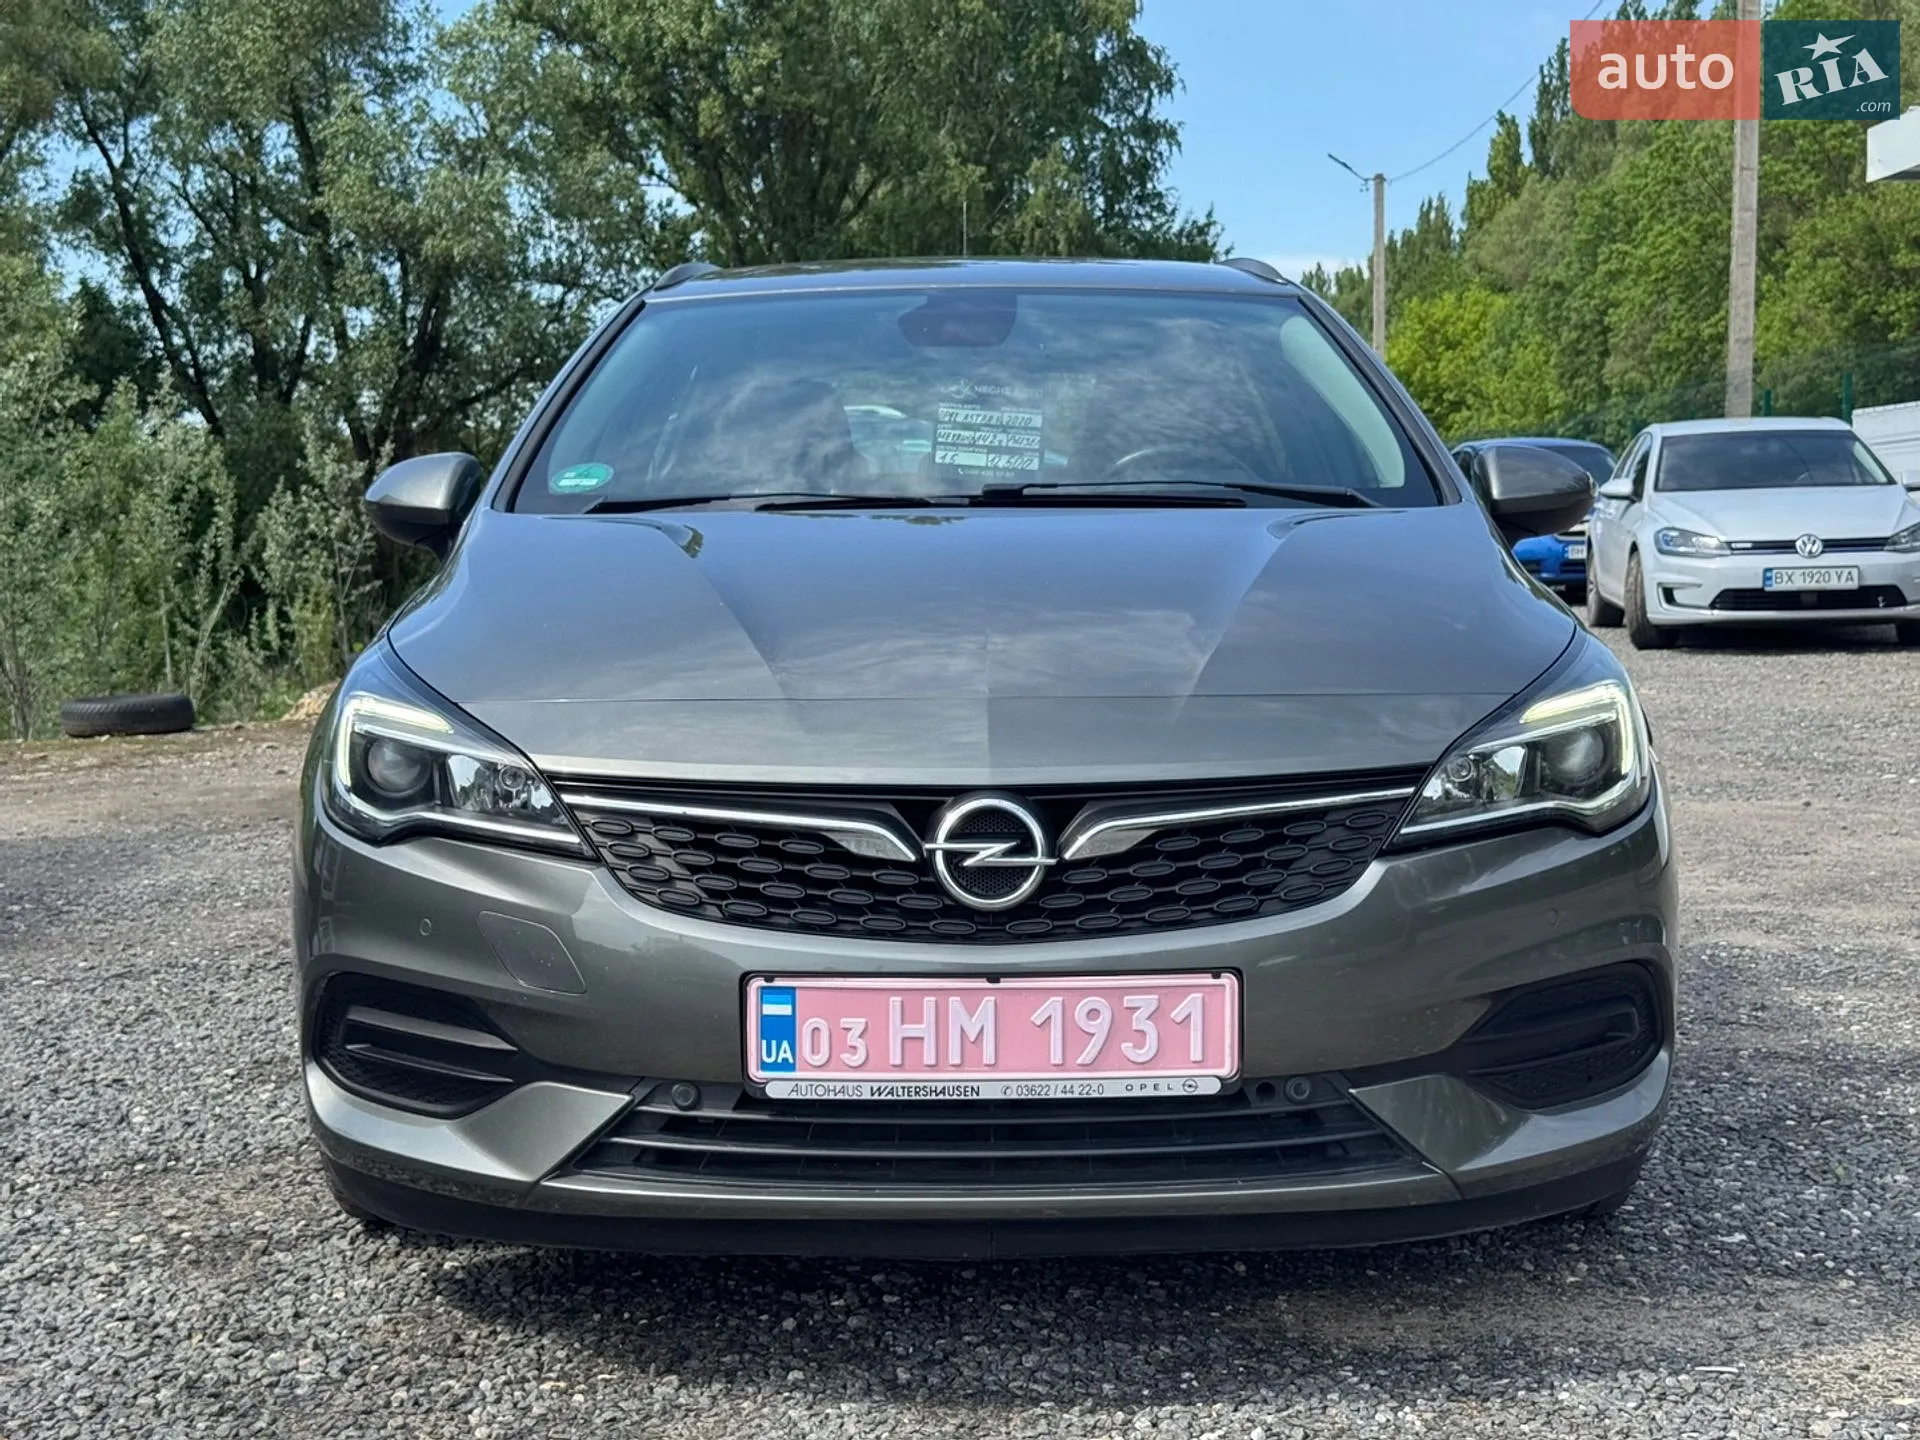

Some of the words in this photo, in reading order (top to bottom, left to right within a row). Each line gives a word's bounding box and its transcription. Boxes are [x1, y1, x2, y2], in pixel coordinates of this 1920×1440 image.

[1774, 571, 1794, 584] BX
[1800, 570, 1831, 583] 1920
[1835, 570, 1854, 584] YA
[761, 1039, 794, 1065] UA
[802, 1018, 868, 1068] 03
[889, 996, 996, 1066] HM
[1030, 993, 1205, 1066] 1931
[788, 1083, 863, 1097] AUTOHAUS
[870, 1085, 980, 1097] WALTERSHAUSEN
[1016, 1084, 1051, 1096] 03622
[1060, 1084, 1075, 1096] 44
[1078, 1083, 1105, 1096] 22-0
[1125, 1082, 1174, 1093] OPEL
